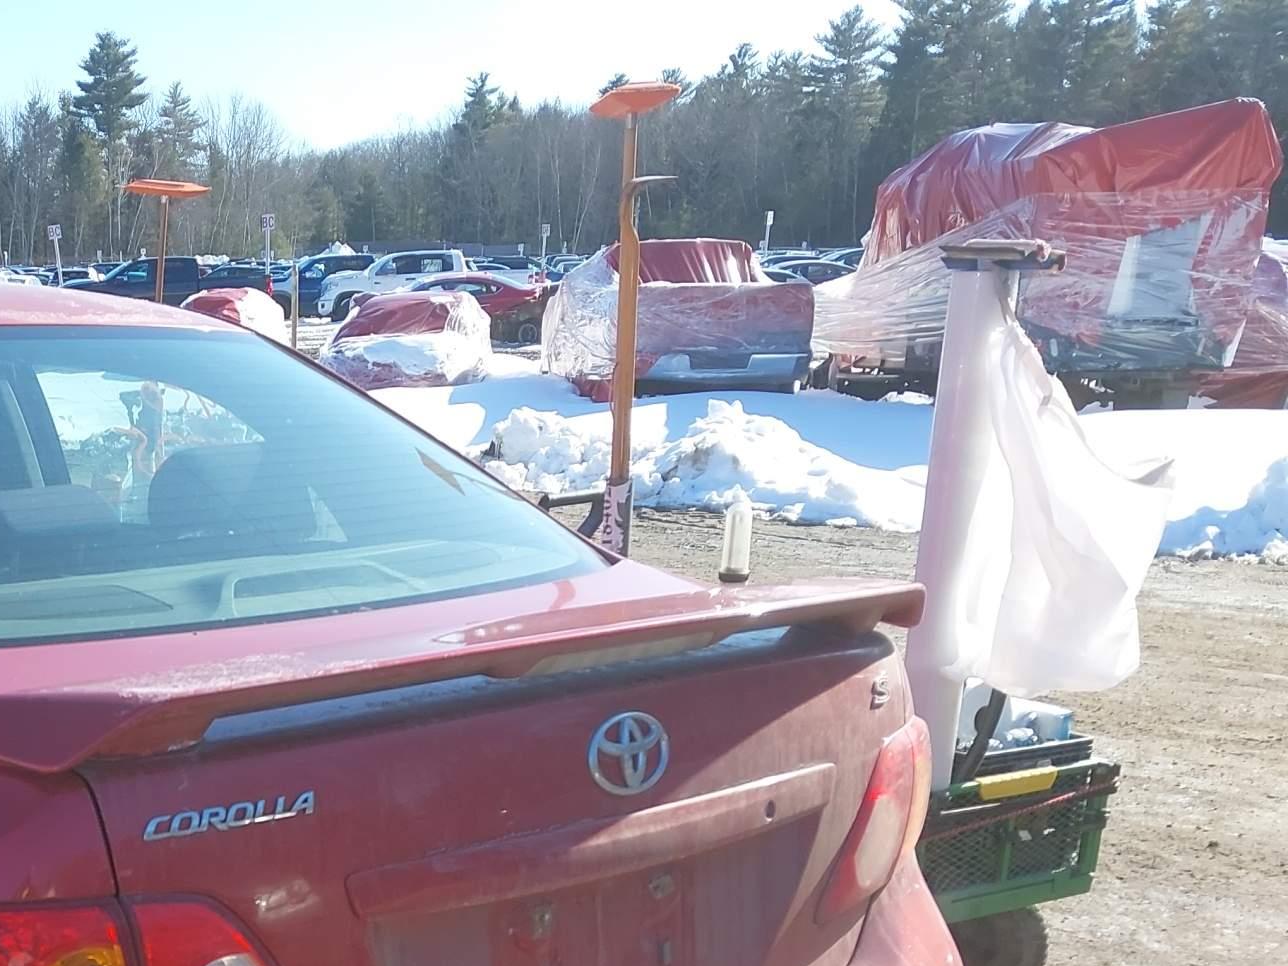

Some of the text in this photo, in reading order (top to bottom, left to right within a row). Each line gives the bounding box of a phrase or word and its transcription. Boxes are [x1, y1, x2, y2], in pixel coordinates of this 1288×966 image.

[263, 216, 274, 229] BC
[48, 226, 61, 238] BC
[143, 790, 315, 841] COROLLA
